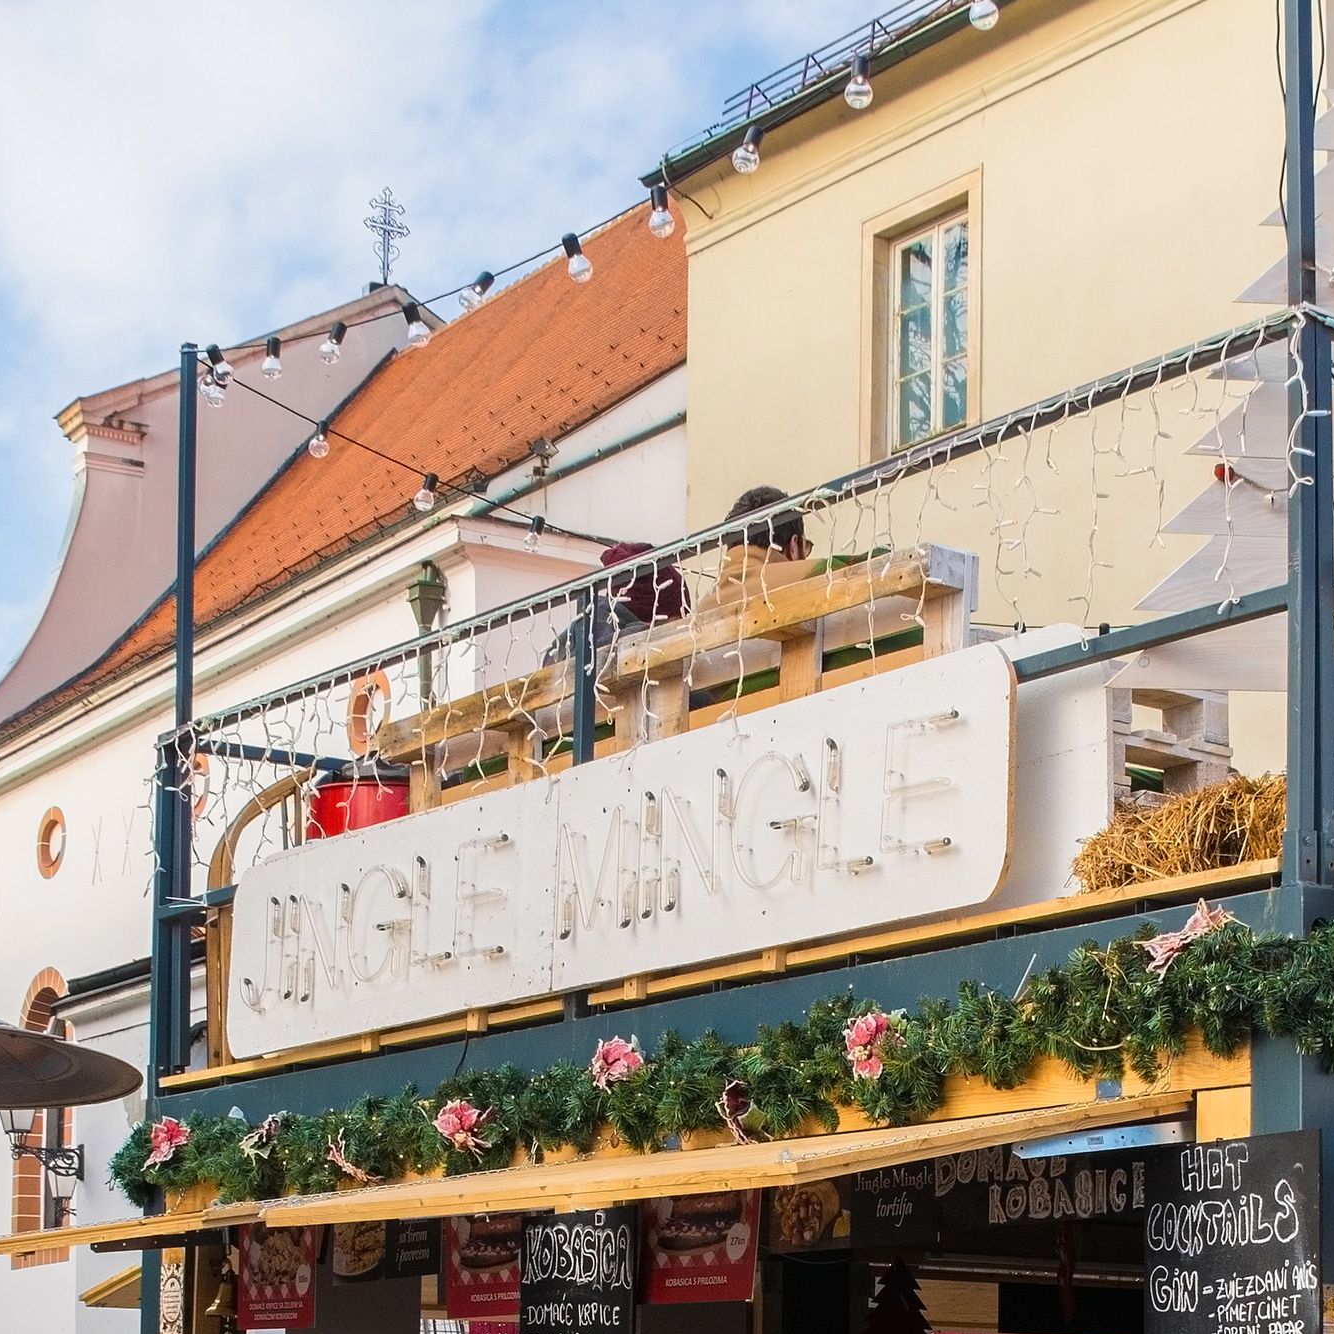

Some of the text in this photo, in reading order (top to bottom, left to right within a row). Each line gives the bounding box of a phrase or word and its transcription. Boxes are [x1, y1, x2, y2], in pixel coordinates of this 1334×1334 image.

[241, 707, 961, 1012] JINGLE MINGLE
[855, 1165, 934, 1193] Jingle Mingle
[1181, 1142, 1249, 1191] HOT
[876, 1192, 913, 1228] tortilja
[988, 1161, 1145, 1224] KOBASICE
[1147, 1179, 1299, 1257] COCKTAILS
[522, 1211, 633, 1292] KOBASICA
[665, 1277, 693, 1287] KOBASICA
[578, 1302, 621, 1327] KRPICE
